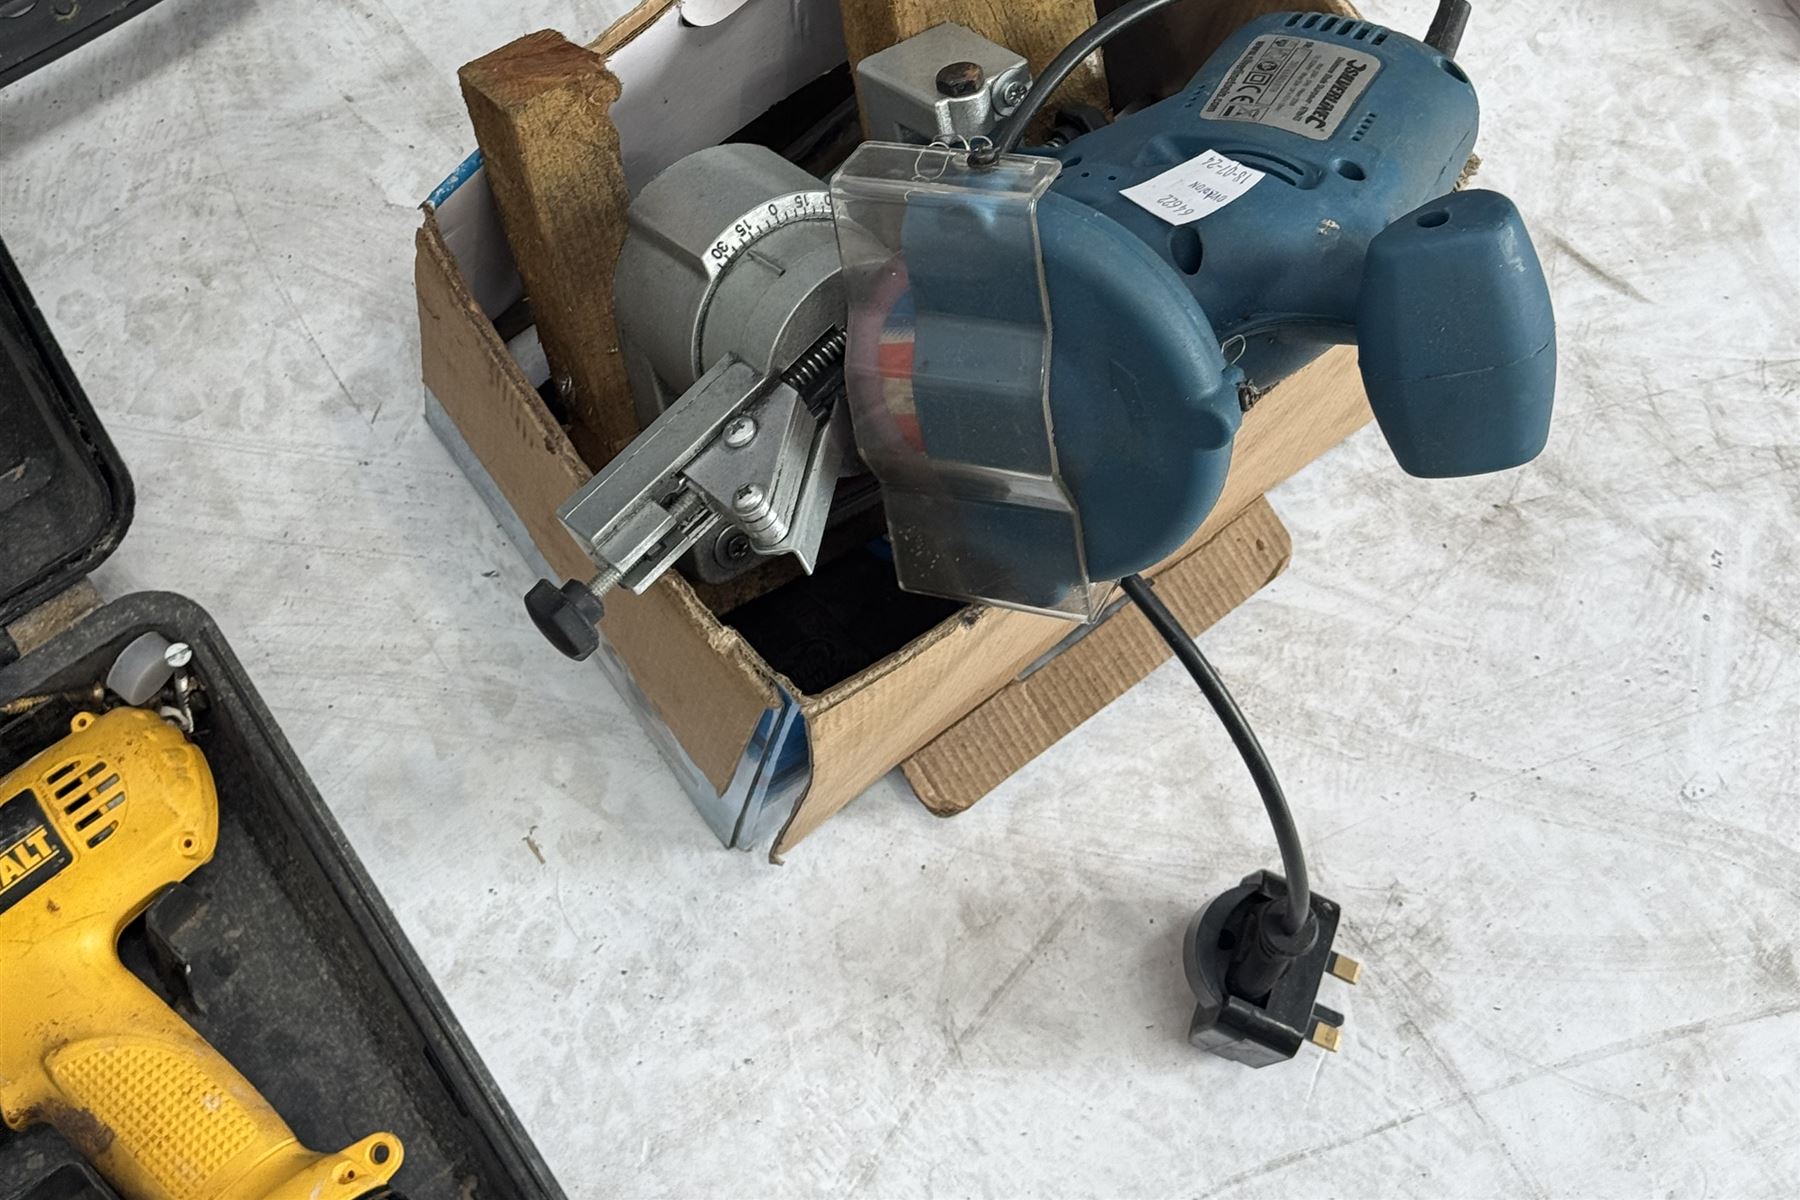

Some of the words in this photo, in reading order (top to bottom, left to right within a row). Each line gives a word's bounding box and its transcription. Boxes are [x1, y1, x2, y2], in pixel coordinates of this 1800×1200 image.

[1312, 65, 1362, 127] SILVERLINE
[1202, 157, 1252, 185] 18-07-24
[768, 203, 778, 216] 0
[794, 195, 811, 208] 15
[1156, 194, 1195, 216] 64622
[735, 220, 752, 237] 15
[711, 241, 729, 260] 30
[0, 828, 53, 889] ALT
